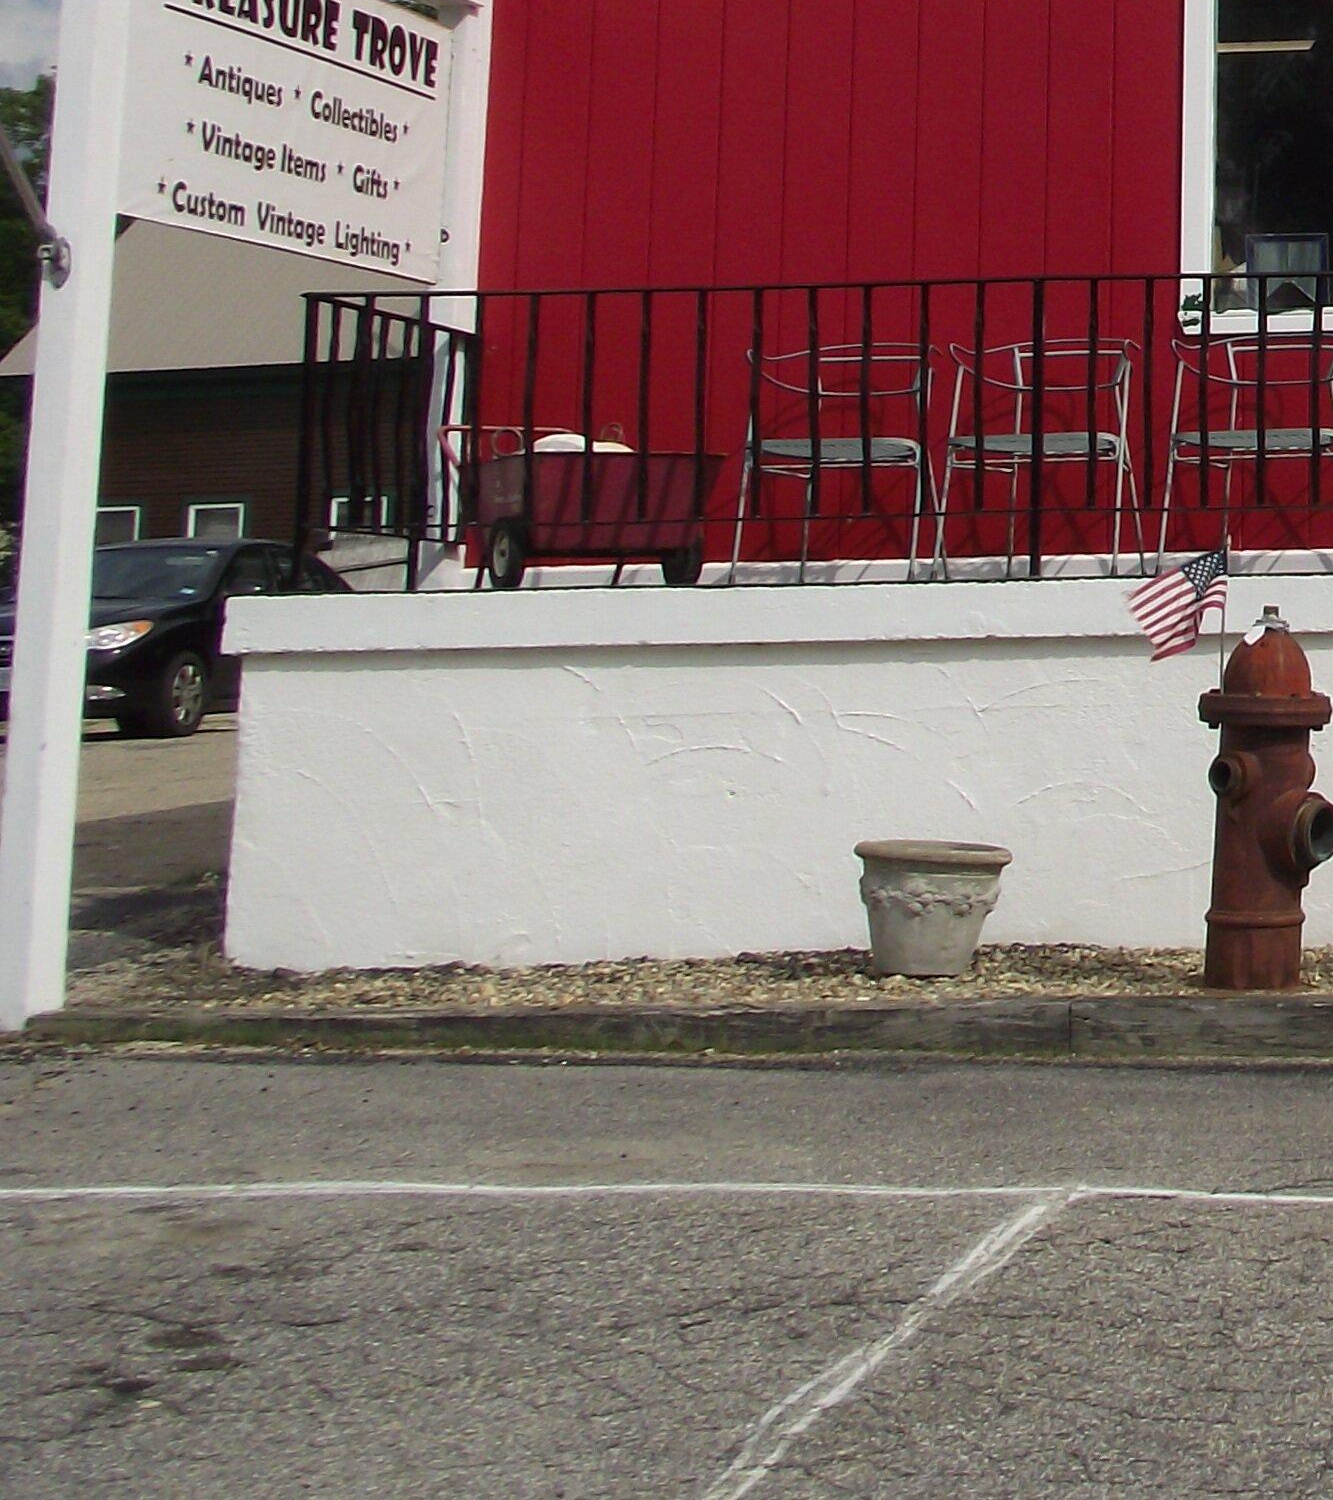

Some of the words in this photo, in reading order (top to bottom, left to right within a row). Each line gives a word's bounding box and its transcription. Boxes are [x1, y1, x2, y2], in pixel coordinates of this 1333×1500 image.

[352, 8, 439, 89] TROVE
[198, 55, 284, 107] Antiques
[310, 90, 398, 143] Collectibles
[200, 121, 276, 172] Vintage
[280, 143, 327, 183] Items
[352, 164, 388, 199] Gifts
[172, 181, 246, 227] Custom
[256, 201, 326, 247] Vintage
[335, 220, 400, 266] Lighting
